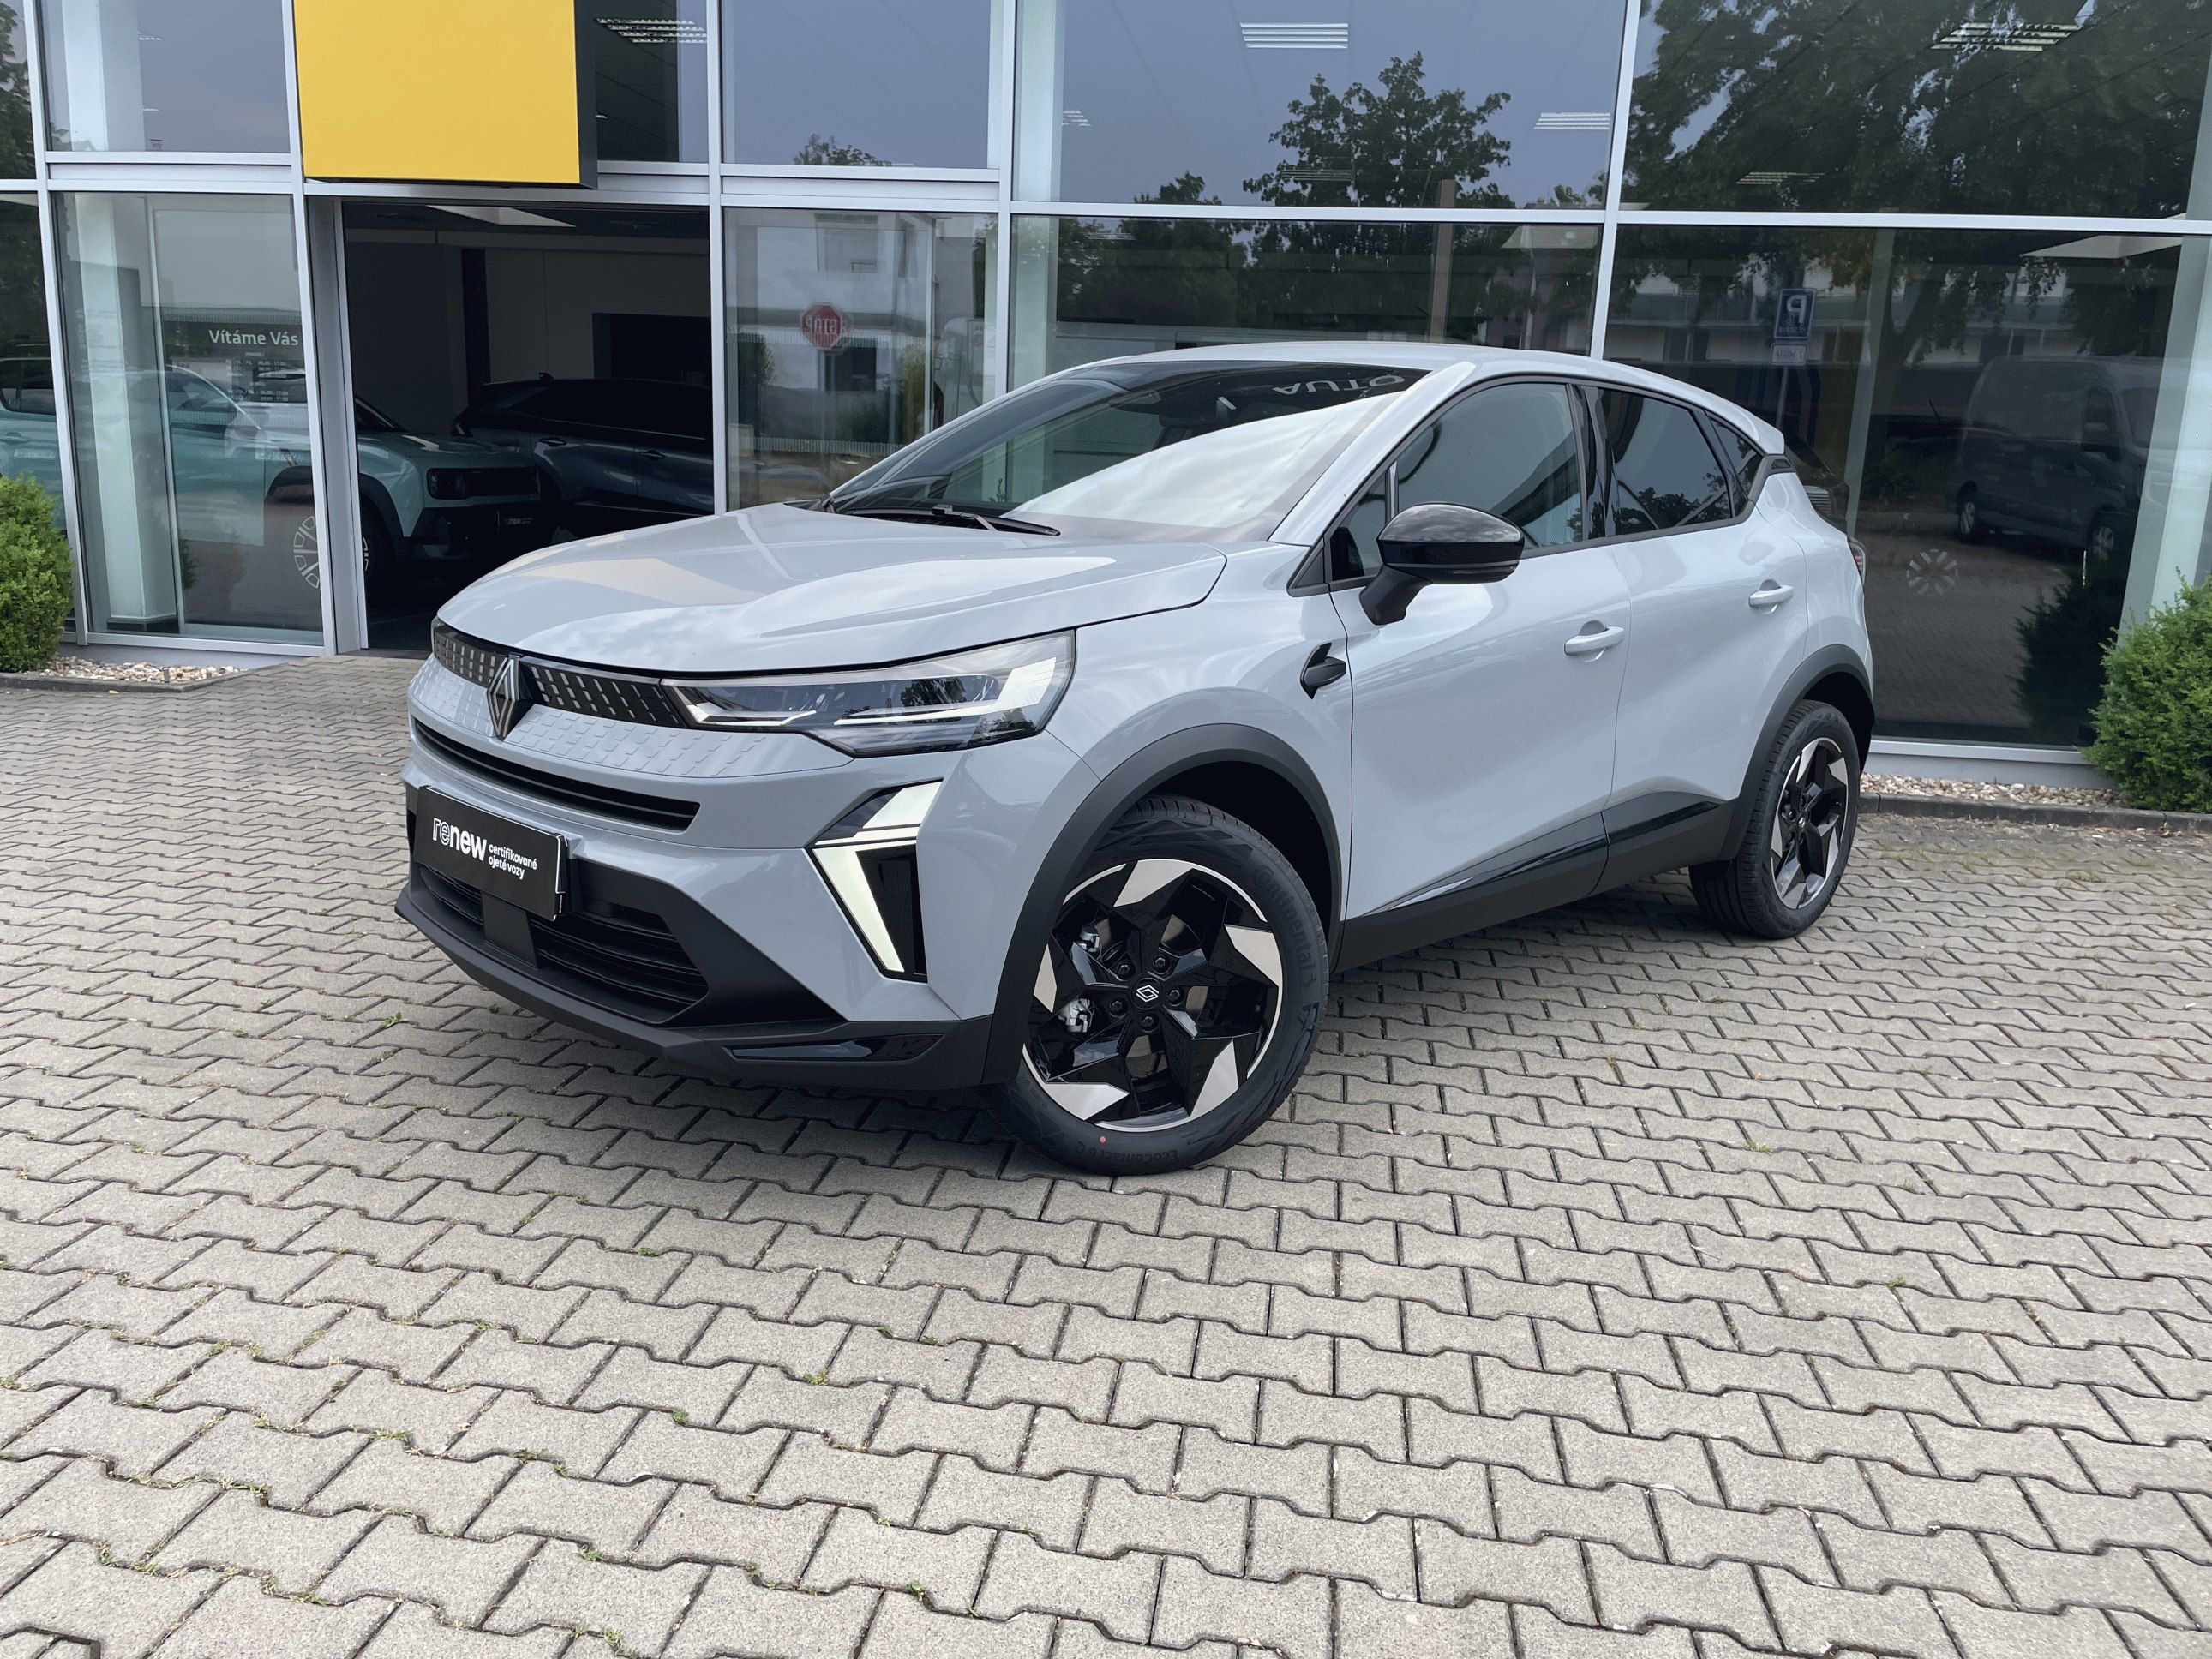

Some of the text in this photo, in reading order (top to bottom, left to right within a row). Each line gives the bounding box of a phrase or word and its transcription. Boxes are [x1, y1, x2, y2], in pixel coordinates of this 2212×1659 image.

[208, 329, 298, 346] Vítáme Vás
[432, 817, 487, 861] renew
[489, 843, 537, 871] certifikované
[489, 855, 525, 880] ojeté vozy
